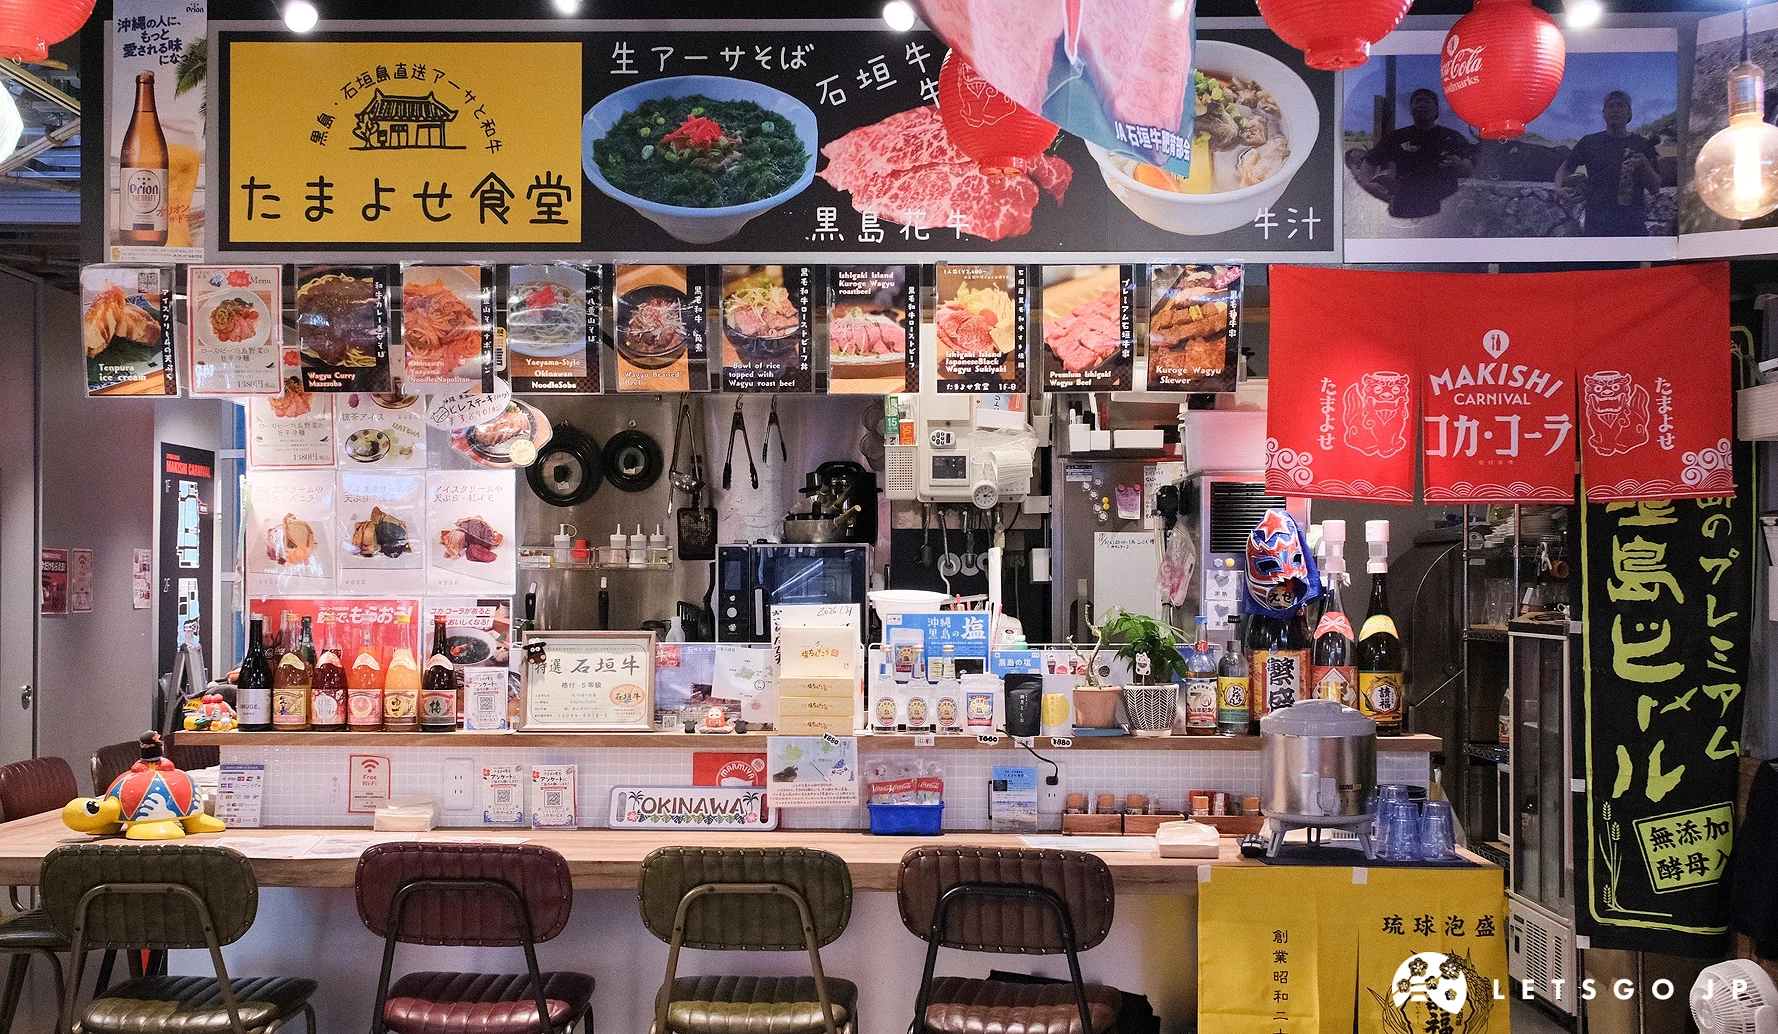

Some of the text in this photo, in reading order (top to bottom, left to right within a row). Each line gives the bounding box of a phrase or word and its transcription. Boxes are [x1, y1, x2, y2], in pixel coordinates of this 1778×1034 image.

[186, 4, 204, 13] Orion
[117, 16, 182, 33] 沖縄の人に、
[140, 28, 170, 43] もっと
[122, 38, 183, 58] 愛される味
[609, 41, 815, 75] 生アーサそば
[815, 41, 931, 107] 石垣牛
[309, 61, 504, 155] 黒島・石垣島直送アーサと和牛
[129, 182, 159, 195] Orion
[241, 170, 573, 225] たまよせ食堂
[811, 205, 970, 244] 黒島花牛
[1253, 206, 1321, 240] 牛汁
[838, 271, 894, 281] Ishigaki Island
[838, 280, 895, 289] Kuroge Wagyu
[838, 287, 872, 295] roastbeef
[799, 267, 809, 371] 黒毛和牛ローストビーフ丼
[907, 286, 916, 369] 黒毛和牛ローストビーフ
[160, 288, 173, 381] アイスクリームの天ぷら
[98, 363, 135, 374] Tenpura
[525, 357, 581, 368] Yaeyama-Style
[754, 361, 764, 370] of
[766, 362, 781, 370] rice
[534, 369, 573, 378] Okinawan
[728, 371, 774, 380] topped with
[946, 366, 1006, 375] Wagyu Sukiyaki
[1049, 371, 1082, 379] Premium
[1155, 365, 1222, 376] Kuroge Wagyu
[98, 372, 147, 382] ice cream
[308, 371, 357, 383] Wagyu Curry
[1076, 379, 1092, 387] Beef
[1159, 375, 1191, 385] Skewer
[1429, 361, 1563, 399] MAKISHI
[308, 379, 343, 388] Mazesoba
[531, 380, 577, 390] NoodleSoba
[728, 379, 796, 389] Wagyu roast beef
[1453, 392, 1532, 406] CARNIVAL
[1316, 376, 1337, 452] たまよせ
[1654, 376, 1676, 452] たまよせ
[887, 417, 897, 427] 15
[1424, 412, 1574, 458] コカ・コーラ
[434, 485, 503, 494] アイスクリームの
[429, 618, 491, 627] もおいしくなる!
[927, 616, 952, 628] 沖縄
[570, 655, 641, 676] 石垣牛
[823, 733, 839, 746] ¥880
[977, 734, 998, 744] ¥660
[1052, 738, 1071, 746] ¥880
[721, 763, 755, 780] MARMIYA
[640, 796, 746, 816] OKINAWA
[1649, 816, 1730, 853] 無添加
[1382, 914, 1497, 938] 琉球泡盛
